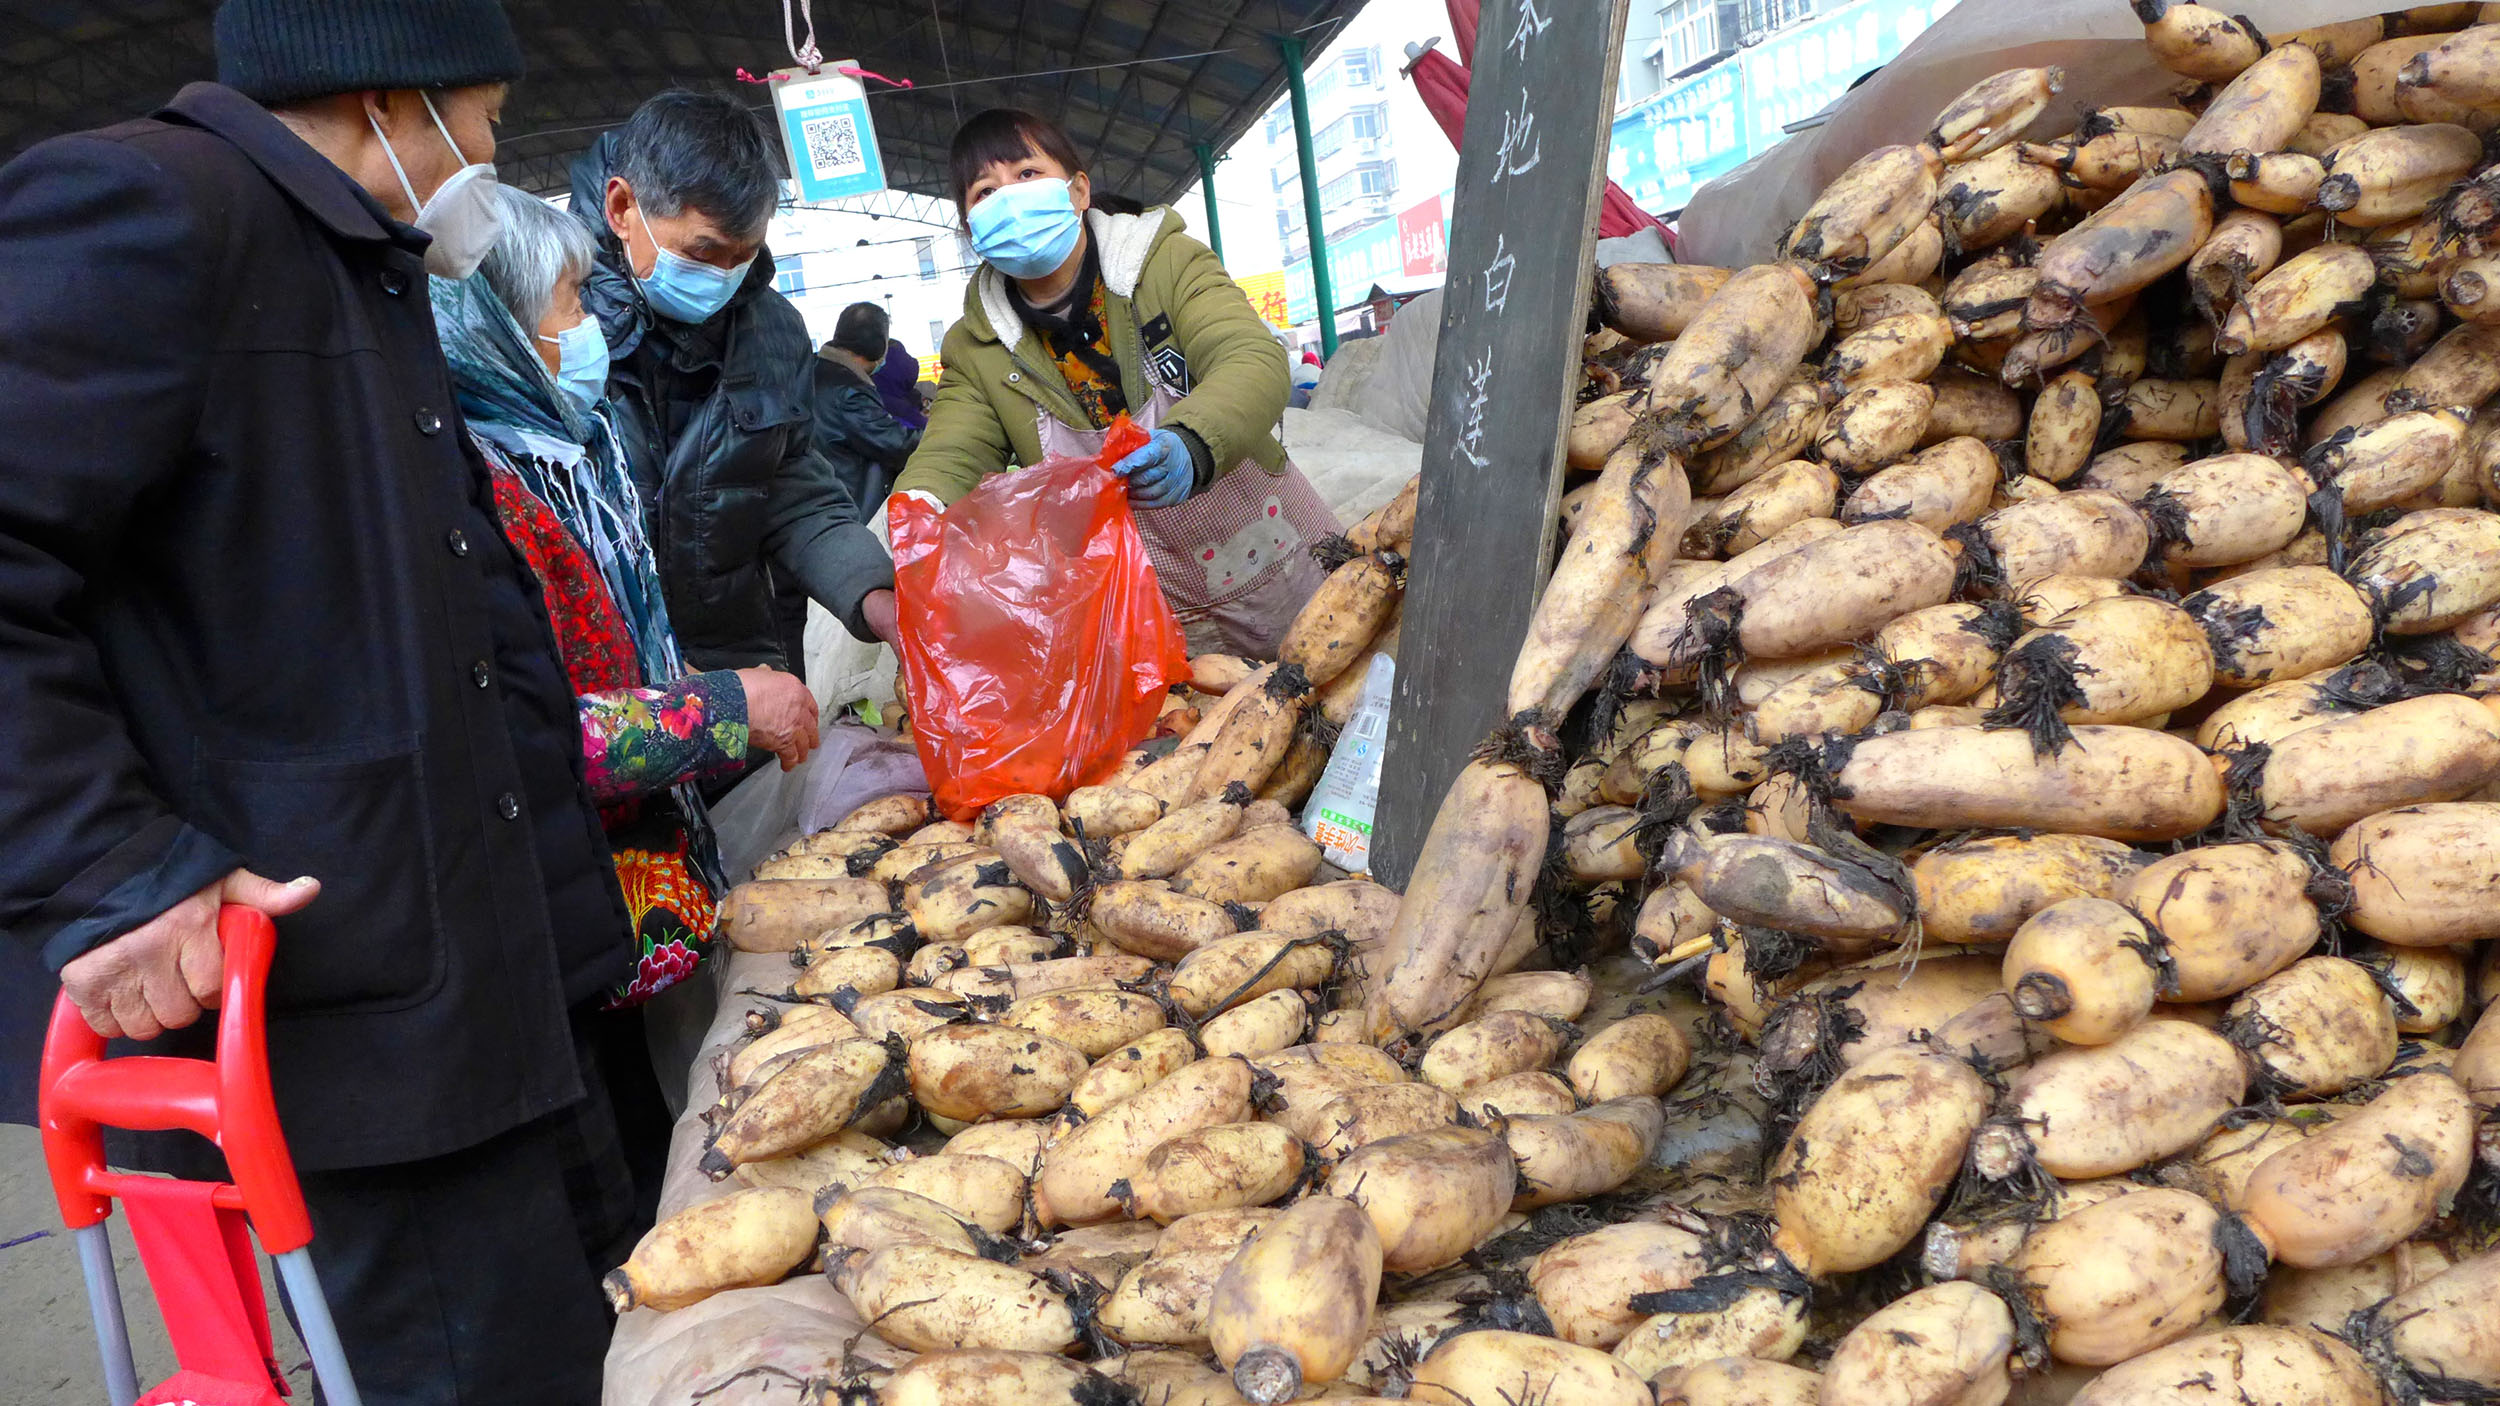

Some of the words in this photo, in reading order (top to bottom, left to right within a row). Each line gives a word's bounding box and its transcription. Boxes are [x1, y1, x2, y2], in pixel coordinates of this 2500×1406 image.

[1315, 821, 1367, 856] 一次性手套
